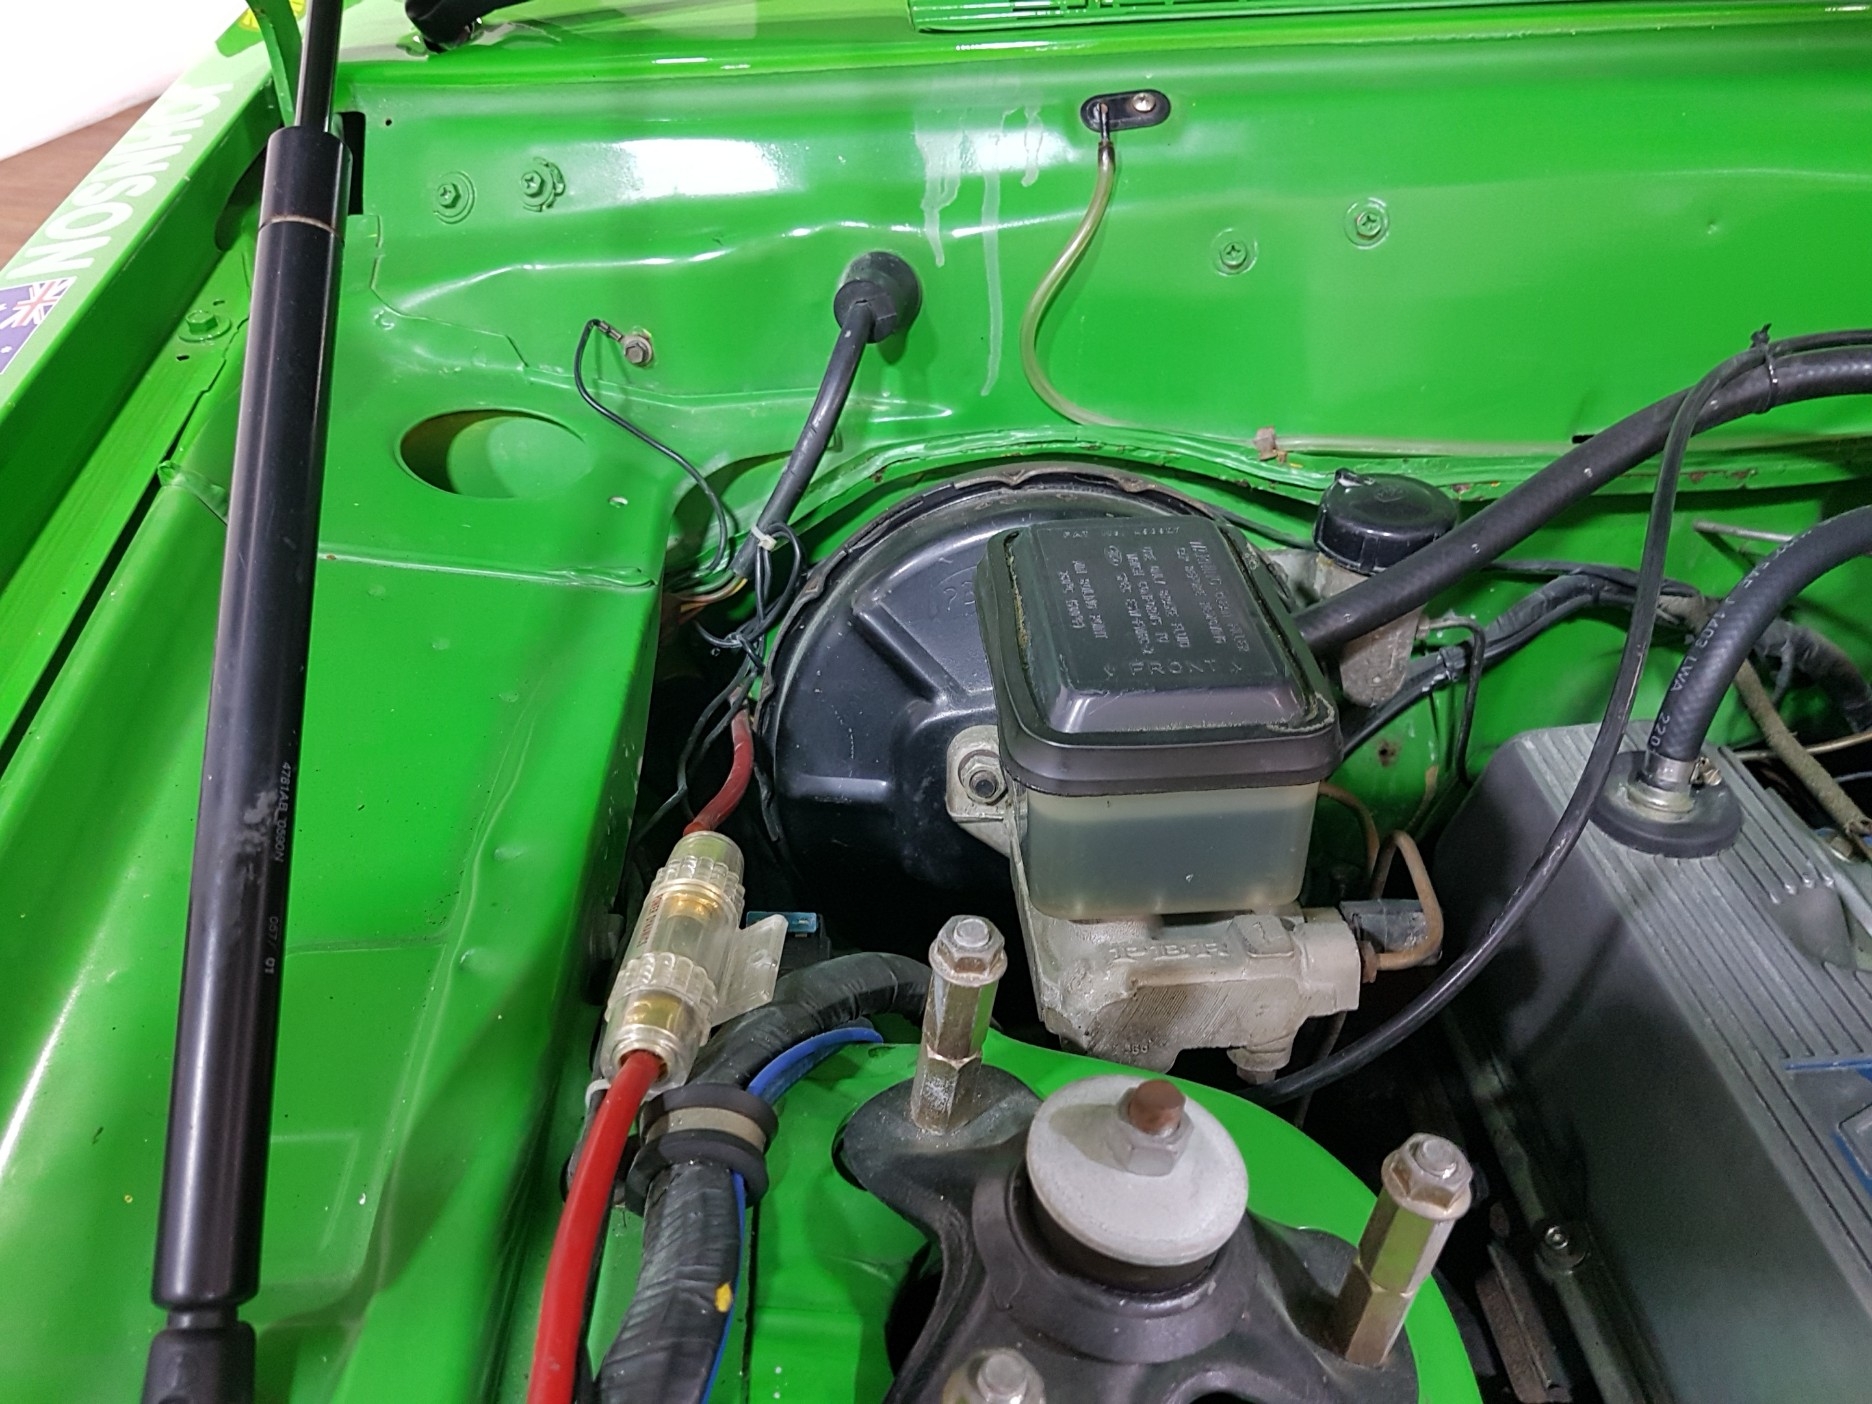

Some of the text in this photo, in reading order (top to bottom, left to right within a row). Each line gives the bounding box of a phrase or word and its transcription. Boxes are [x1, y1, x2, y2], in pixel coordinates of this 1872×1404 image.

[7, 82, 234, 280] JOHNSON
[1130, 659, 1216, 676] FRONT
[1671, 656, 1697, 692] LWA
[1651, 712, 1671, 747] 220
